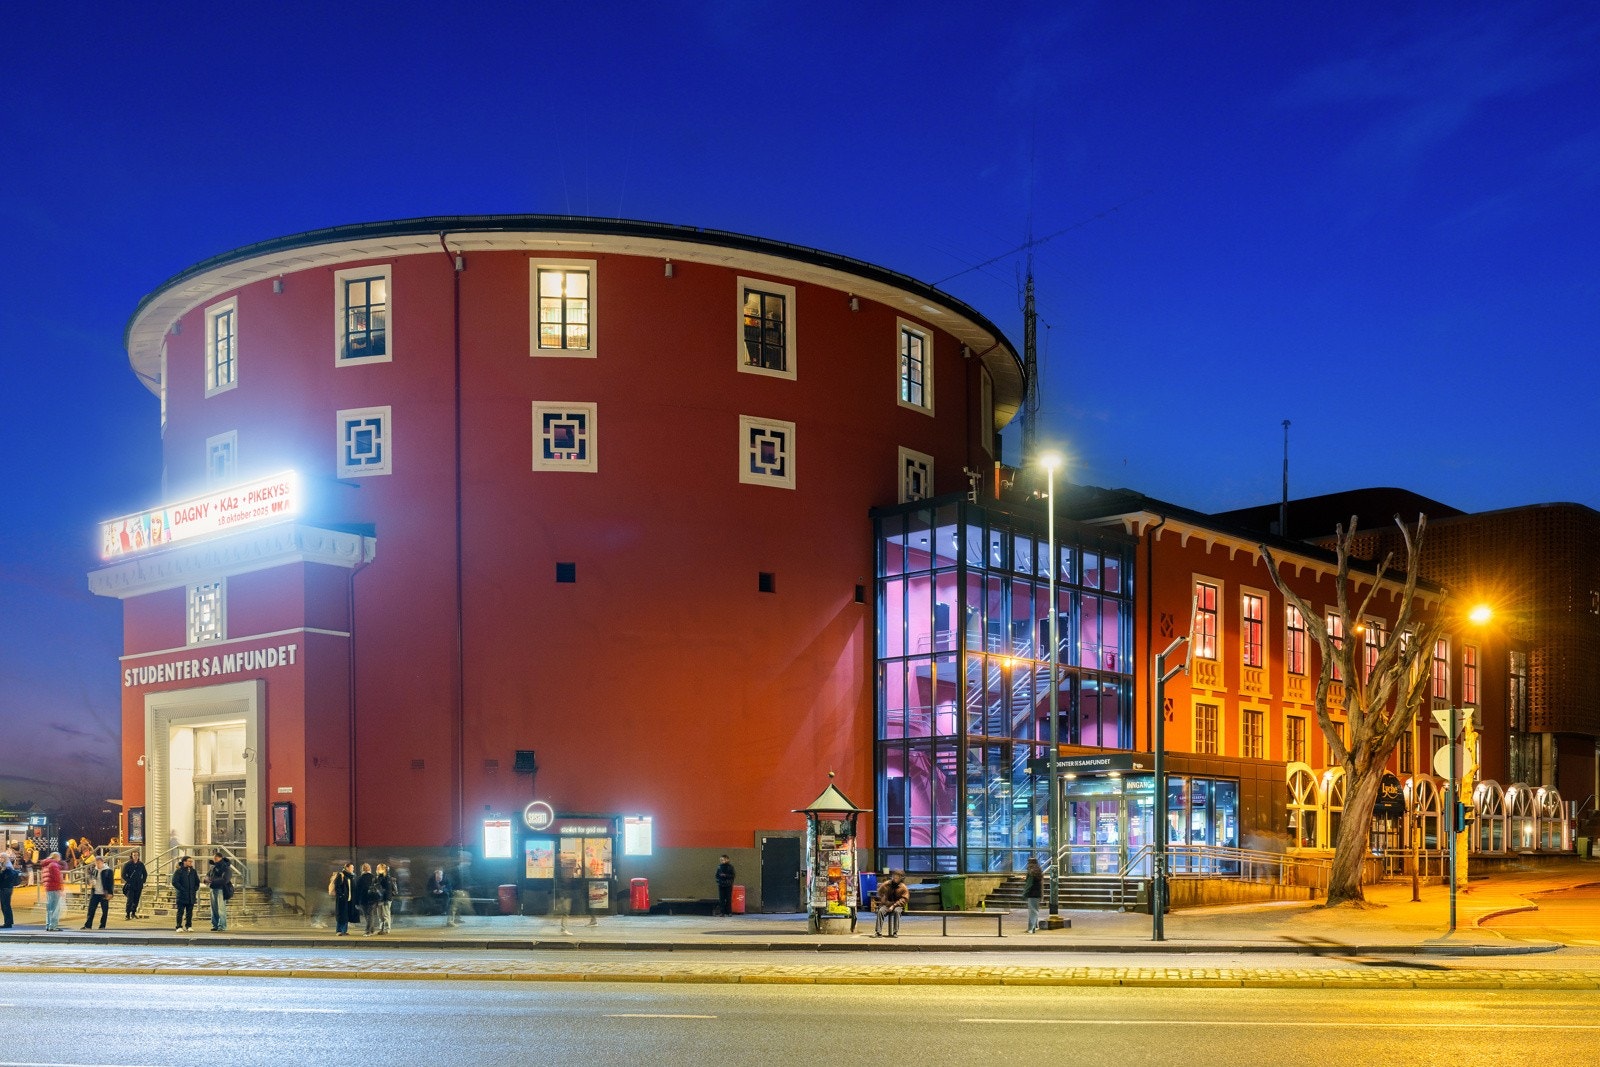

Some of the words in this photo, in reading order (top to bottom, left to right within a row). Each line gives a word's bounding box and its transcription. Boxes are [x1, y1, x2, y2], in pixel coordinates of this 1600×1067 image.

[174, 502, 209, 526] DAGNY
[220, 497, 238, 512] KA2
[248, 482, 290, 504] PIKEKYSS
[218, 516, 225, 526] 18
[226, 510, 251, 523] oktober
[253, 506, 269, 517] 2025
[124, 644, 297, 687] STUDENTERSAMFUNDET
